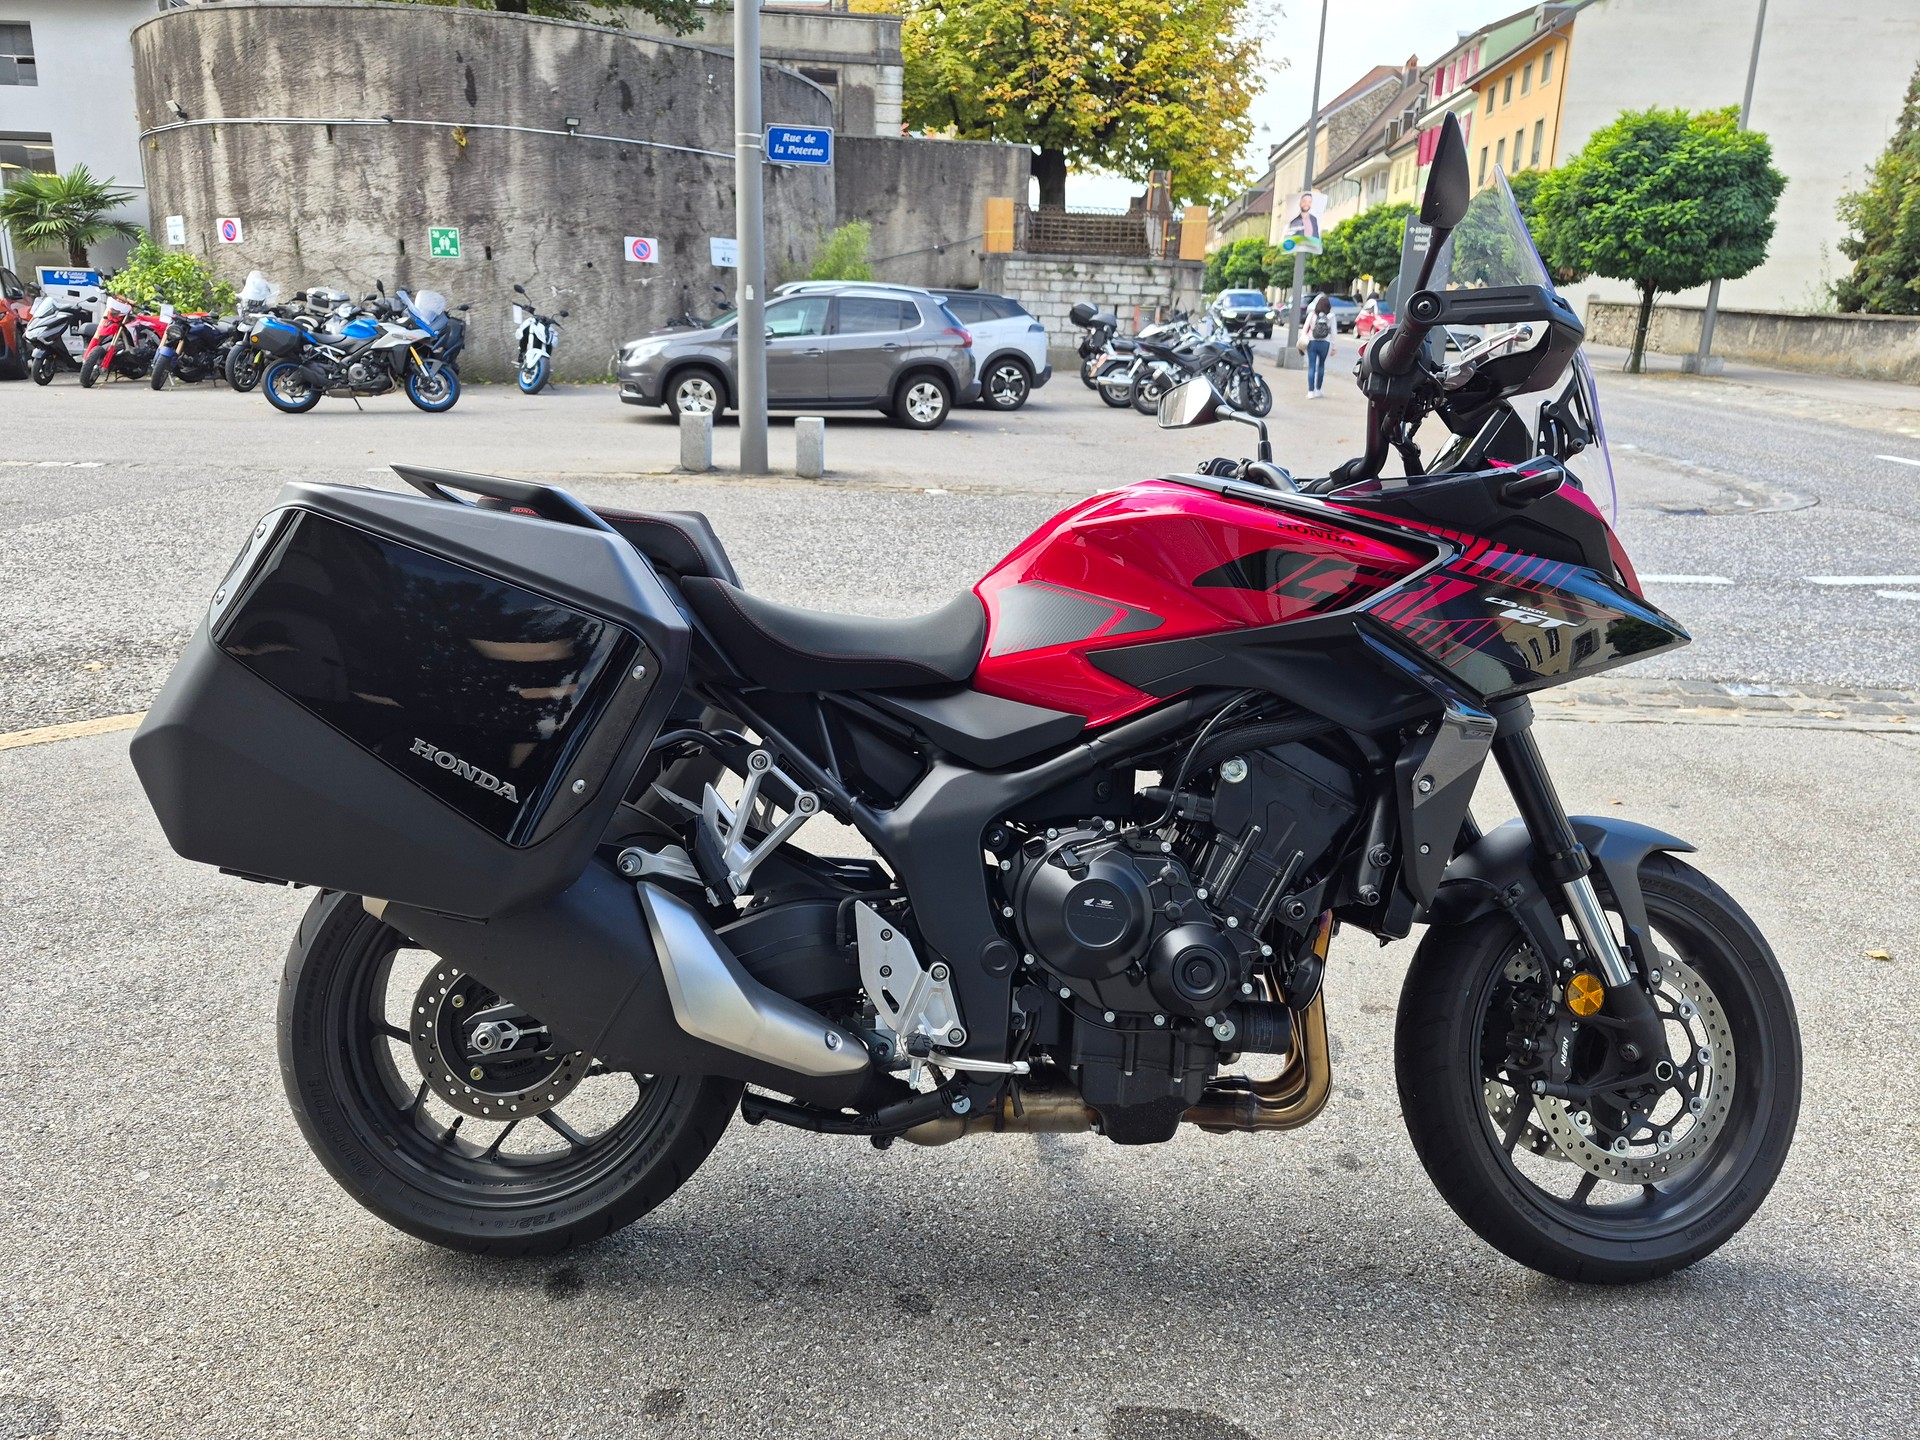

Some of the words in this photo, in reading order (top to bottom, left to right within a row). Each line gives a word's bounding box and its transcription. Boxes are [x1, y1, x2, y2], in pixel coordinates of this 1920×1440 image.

[783, 133, 801, 142] Rue
[804, 134, 816, 143] de
[774, 144, 784, 153] la
[788, 146, 824, 156] Poterne
[1277, 521, 1356, 547] HONDA
[1498, 608, 1579, 628] GT
[410, 737, 519, 804] HONDA
